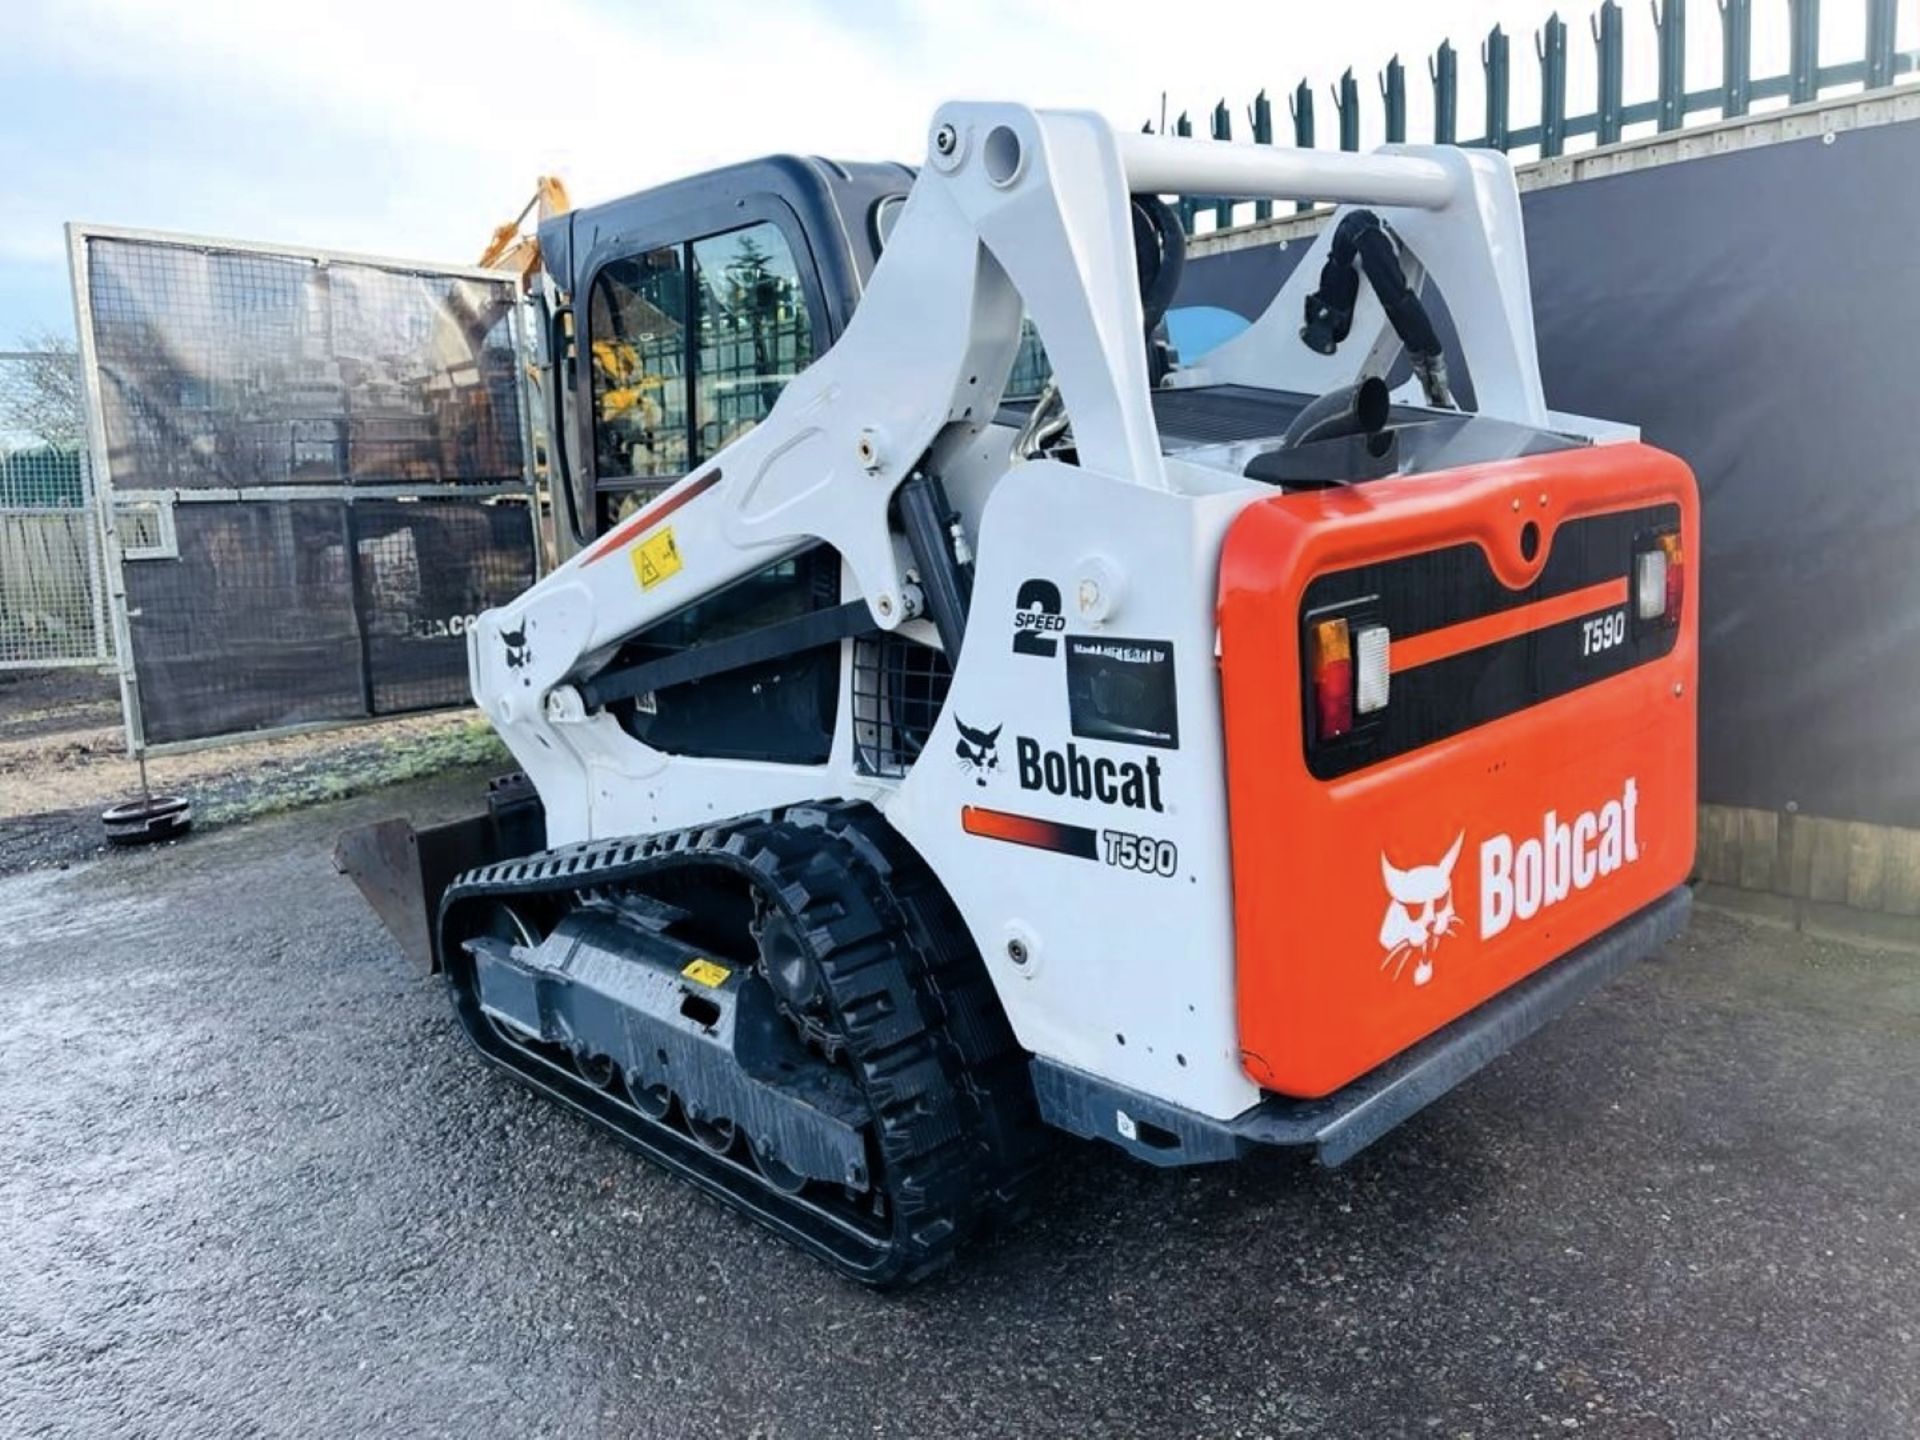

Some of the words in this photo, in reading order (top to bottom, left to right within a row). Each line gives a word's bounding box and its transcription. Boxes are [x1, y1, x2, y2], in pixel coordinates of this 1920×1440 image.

[1012, 578, 1062, 658] 2
[1014, 612, 1066, 632] SPEED
[1583, 610, 1625, 657] T590
[1016, 735, 1164, 813] Bobcat
[1102, 828, 1178, 878] T590
[1480, 776, 1639, 940] Bobcat
